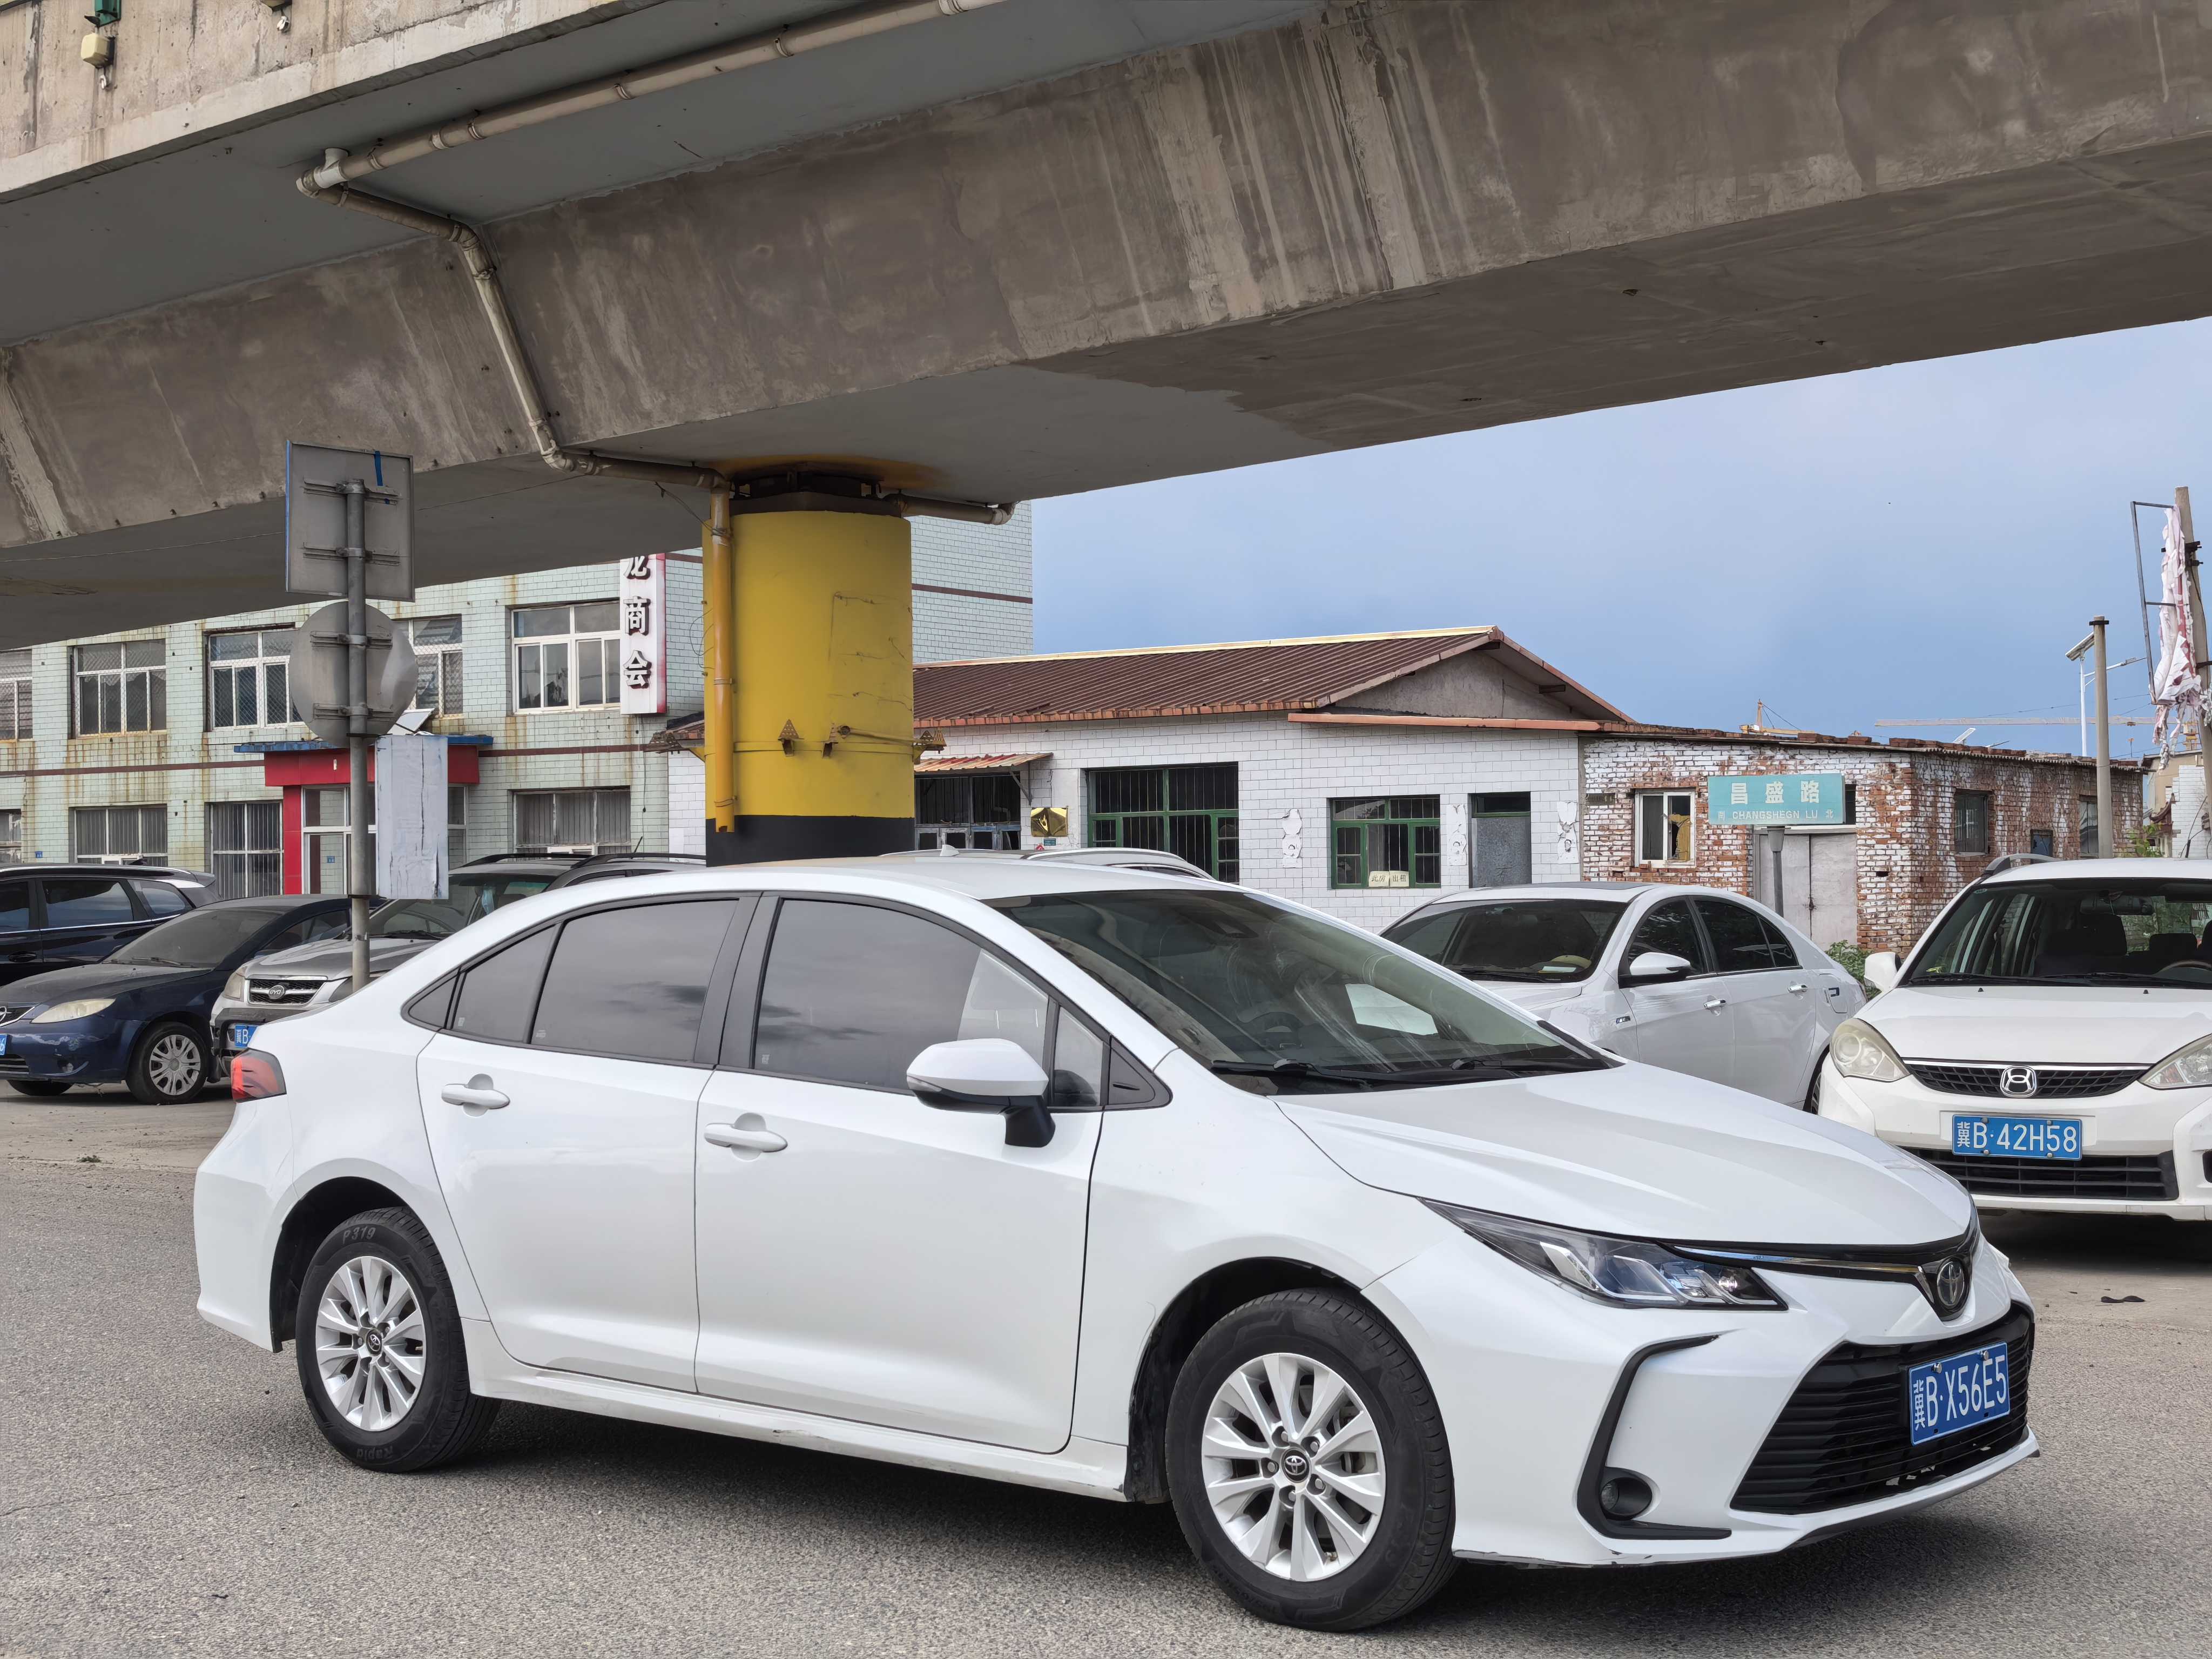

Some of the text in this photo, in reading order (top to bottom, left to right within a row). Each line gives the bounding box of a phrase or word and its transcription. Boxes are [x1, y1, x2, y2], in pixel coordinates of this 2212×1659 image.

[1731, 780, 1819, 805] 昌盛路
[1805, 810, 1818, 818] LU
[1825, 809, 1834, 819] 北
[342, 1225, 376, 1245] P319
